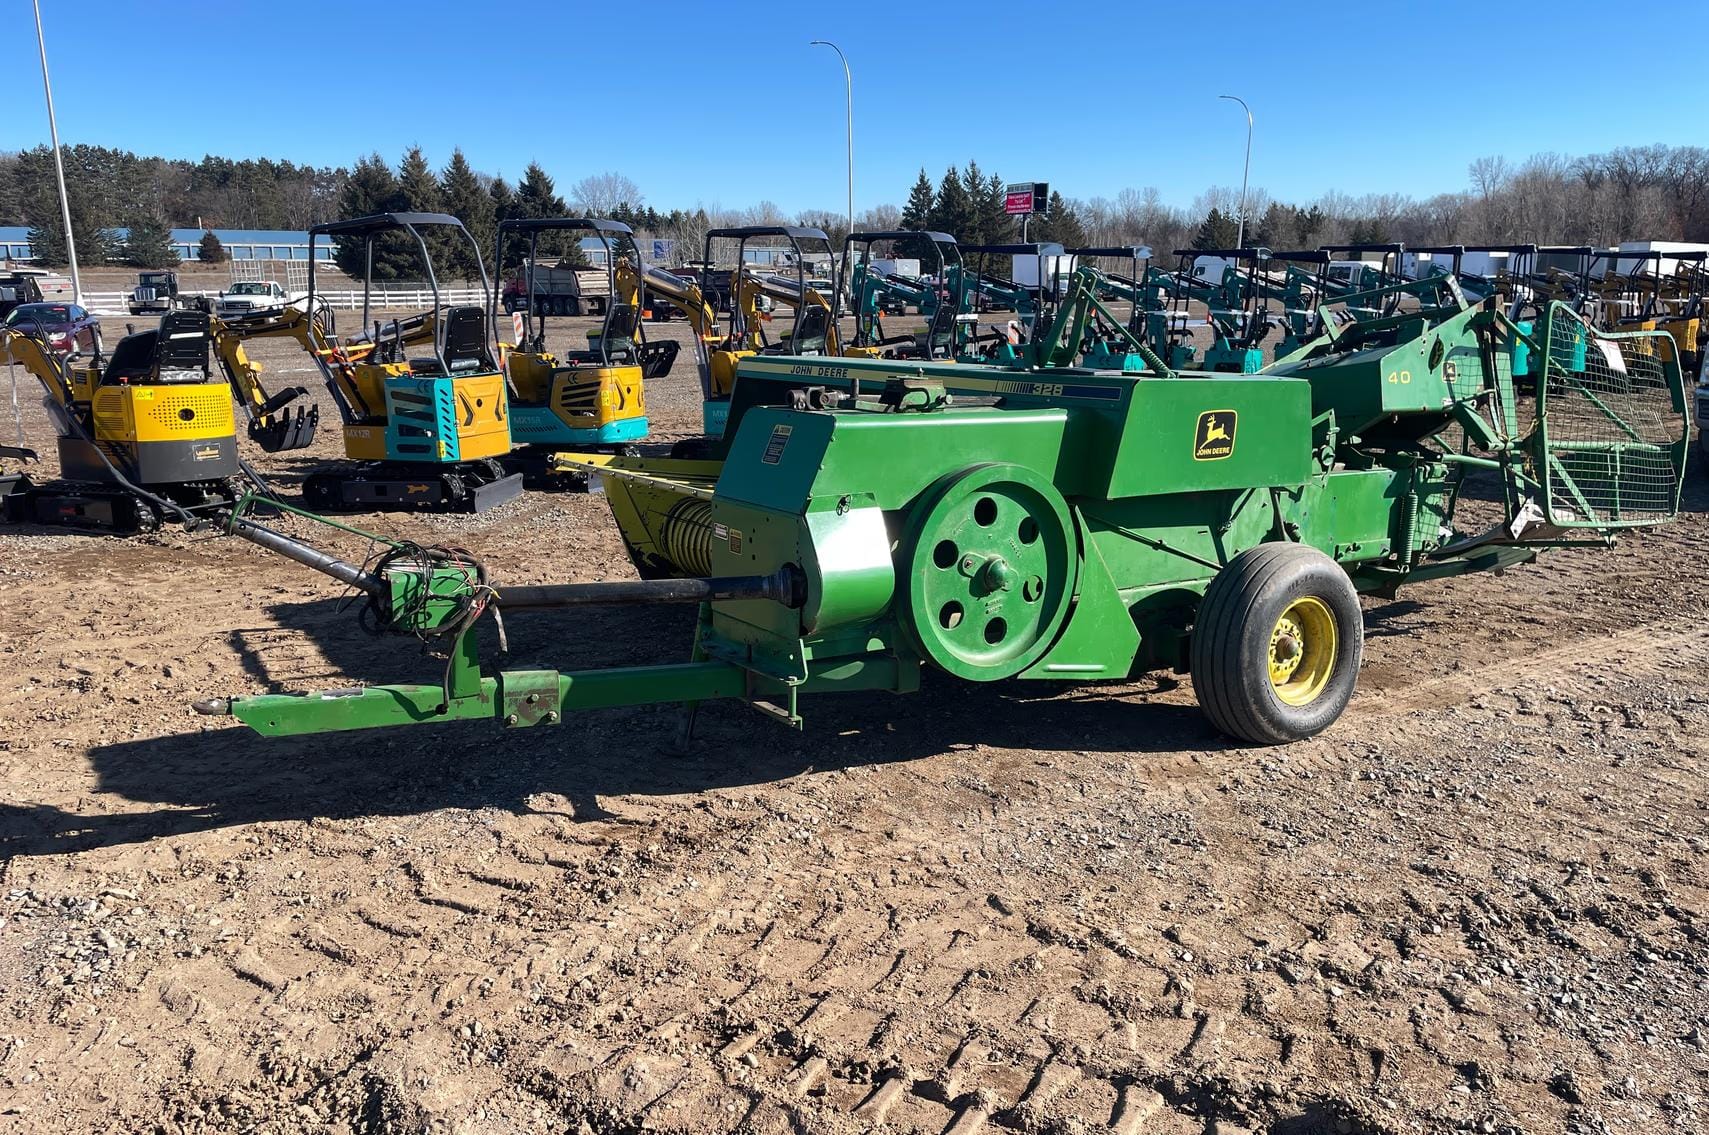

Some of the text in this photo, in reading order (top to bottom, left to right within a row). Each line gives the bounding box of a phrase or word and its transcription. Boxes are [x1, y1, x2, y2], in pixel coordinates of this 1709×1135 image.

[791, 366, 848, 378] JOHN DEERE
[1388, 371, 1411, 384] 40
[1033, 383, 1064, 396] 328
[1197, 447, 1230, 456] JOHN DEERE
